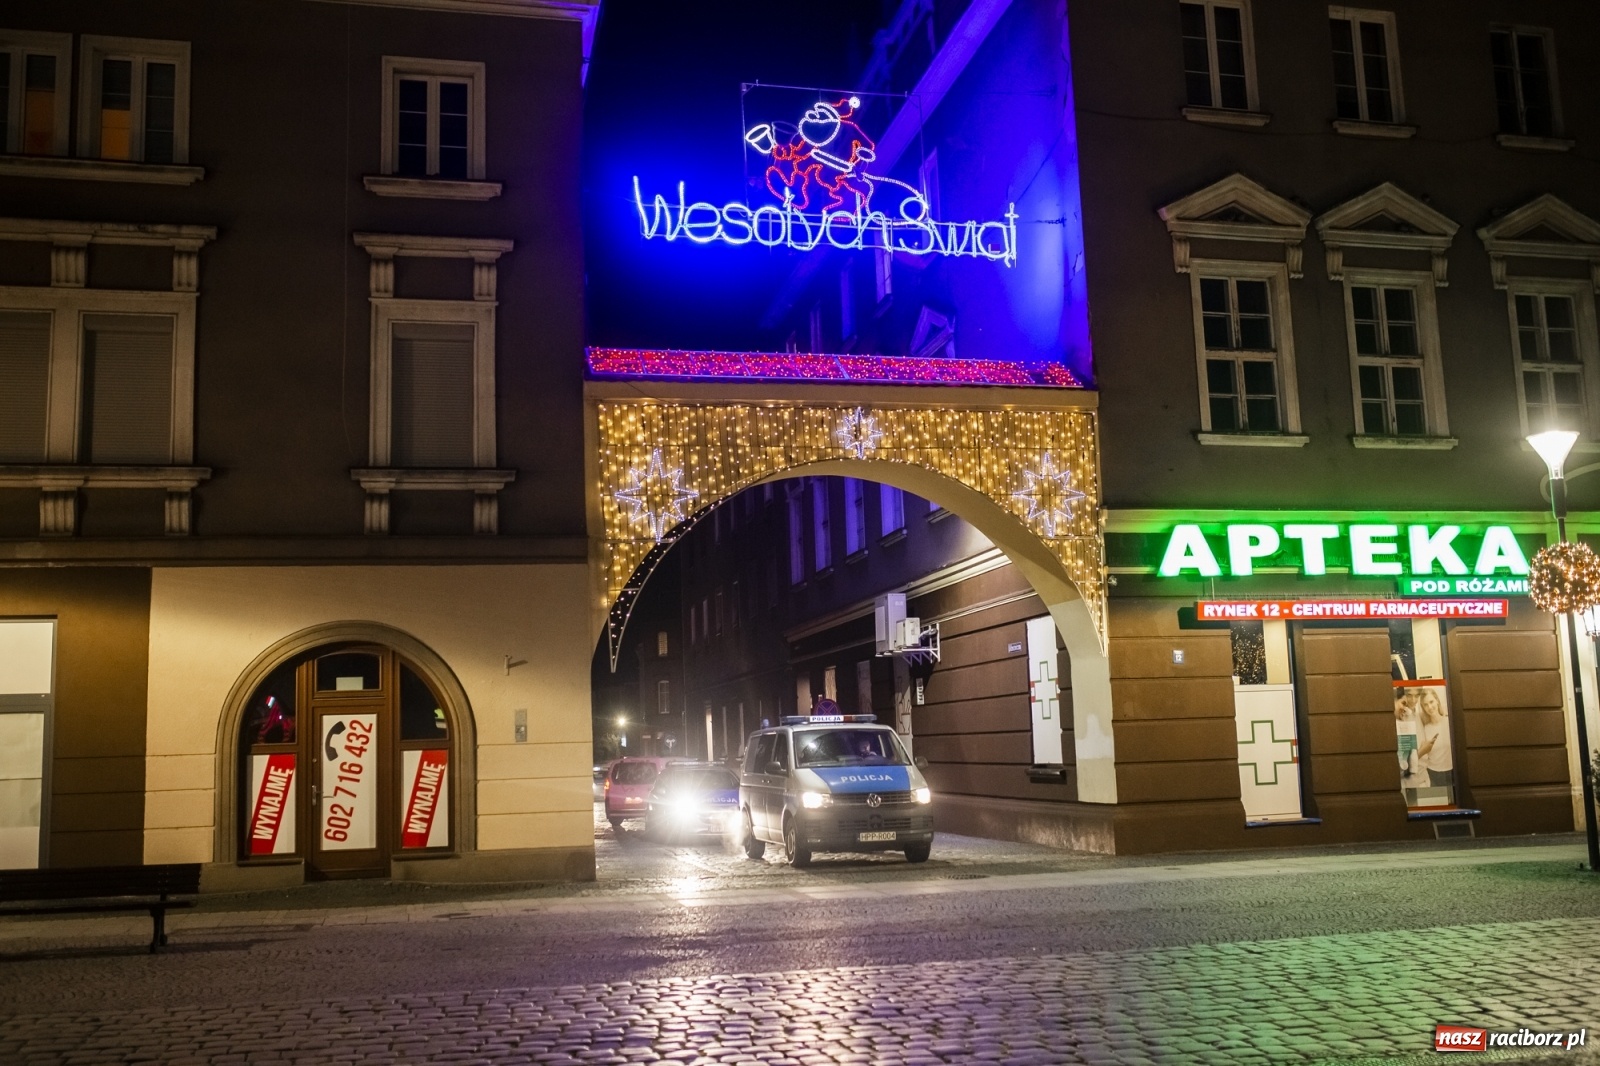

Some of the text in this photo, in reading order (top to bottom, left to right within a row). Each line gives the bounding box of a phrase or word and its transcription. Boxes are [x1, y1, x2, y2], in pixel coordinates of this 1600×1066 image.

[1157, 523, 1530, 578] APTEKA
[1203, 604, 1259, 617] RYNEK
[1261, 603, 1281, 617] 12
[1291, 603, 1367, 616] CENTRUM
[1369, 602, 1503, 615] FARMACEUTYCZNE
[1410, 577, 1529, 593] POD RÓŻAMI
[252, 765, 294, 840] WYNAJMĘ
[323, 719, 373, 843] 602 716 432
[407, 761, 445, 834] WYNAJMĘ
[840, 773, 893, 784] POLICJA
